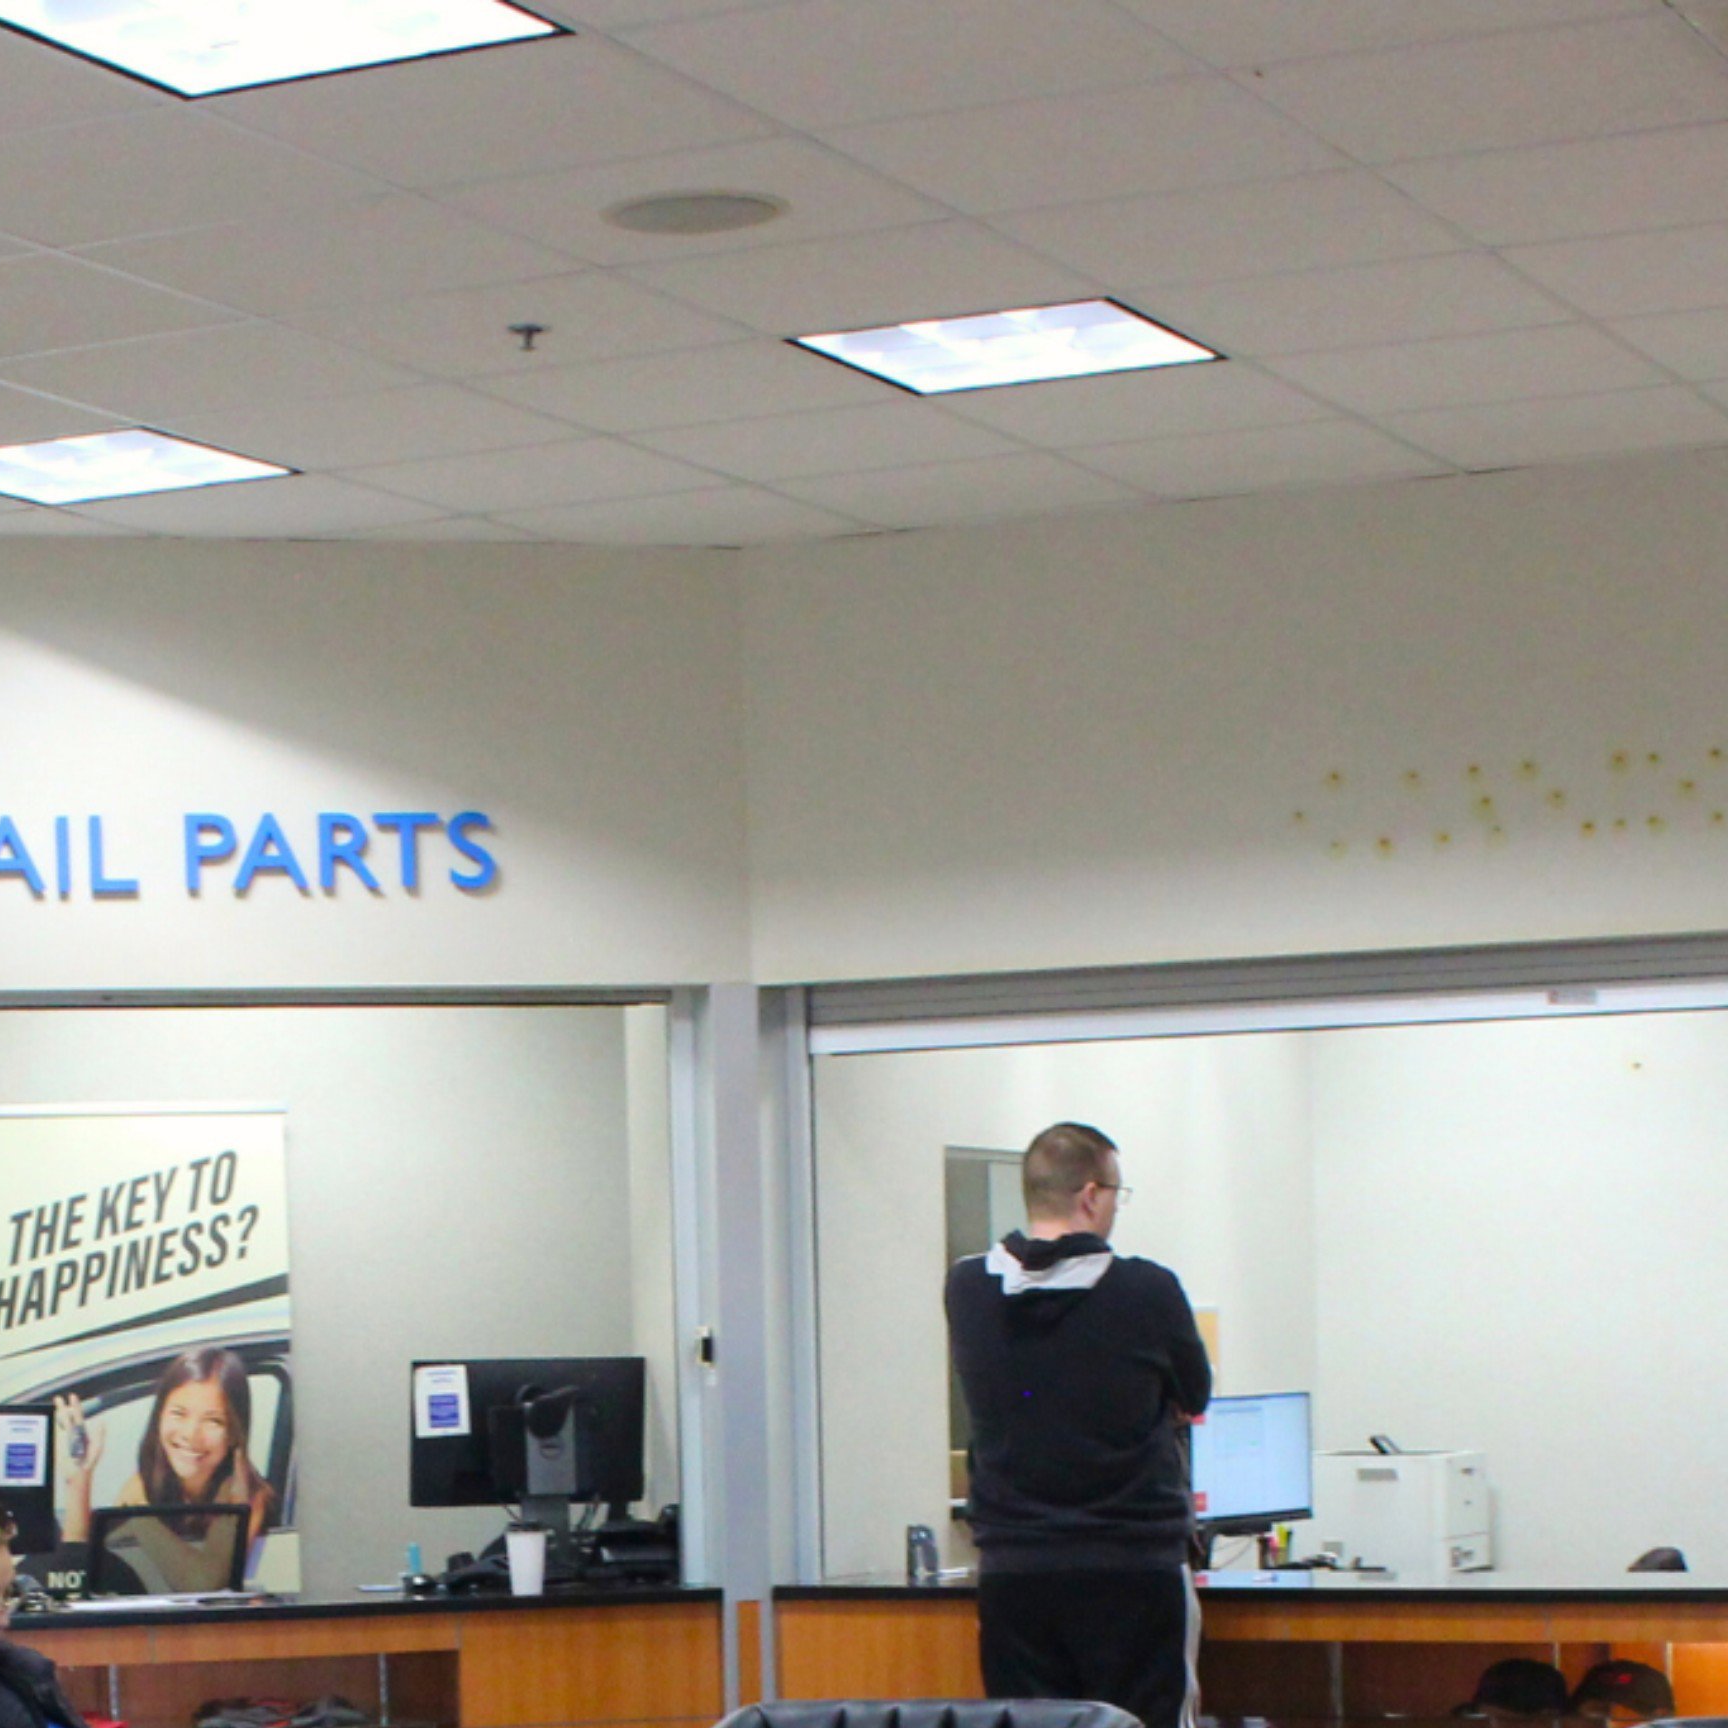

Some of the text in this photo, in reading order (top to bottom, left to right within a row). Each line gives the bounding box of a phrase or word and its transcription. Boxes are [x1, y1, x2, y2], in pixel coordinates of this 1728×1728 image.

[184, 810, 498, 890] PARTS
[9, 1149, 238, 1266] THE KEY TO
[47, 1569, 87, 1589] NO
